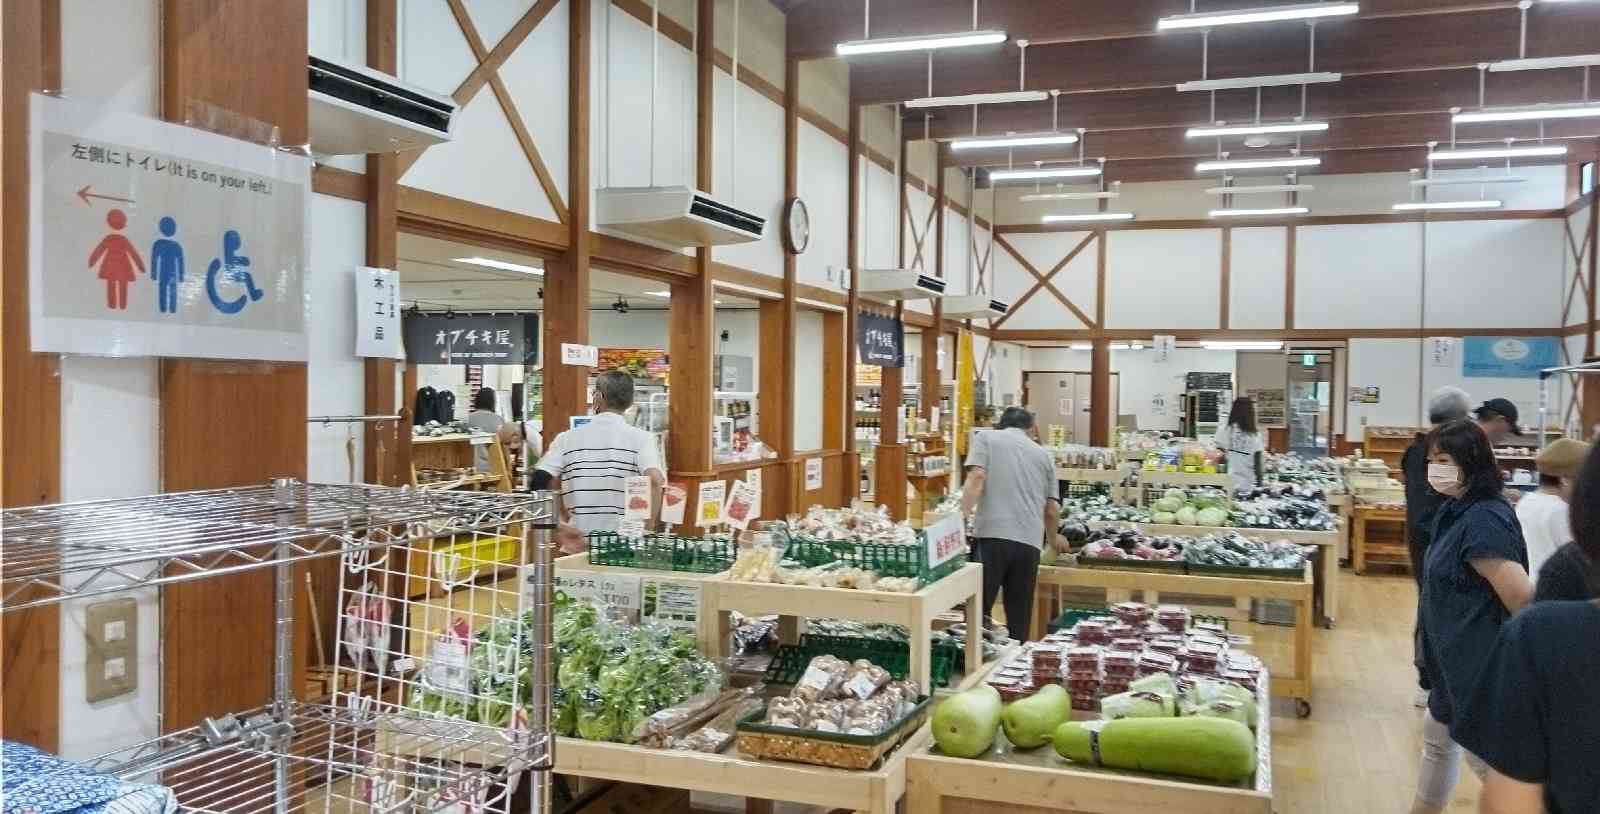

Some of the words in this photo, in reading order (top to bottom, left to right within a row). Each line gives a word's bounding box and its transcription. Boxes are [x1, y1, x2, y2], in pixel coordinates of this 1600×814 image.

[186, 166, 198, 179] is
[201, 172, 217, 183] on
[219, 175, 246, 189] your
